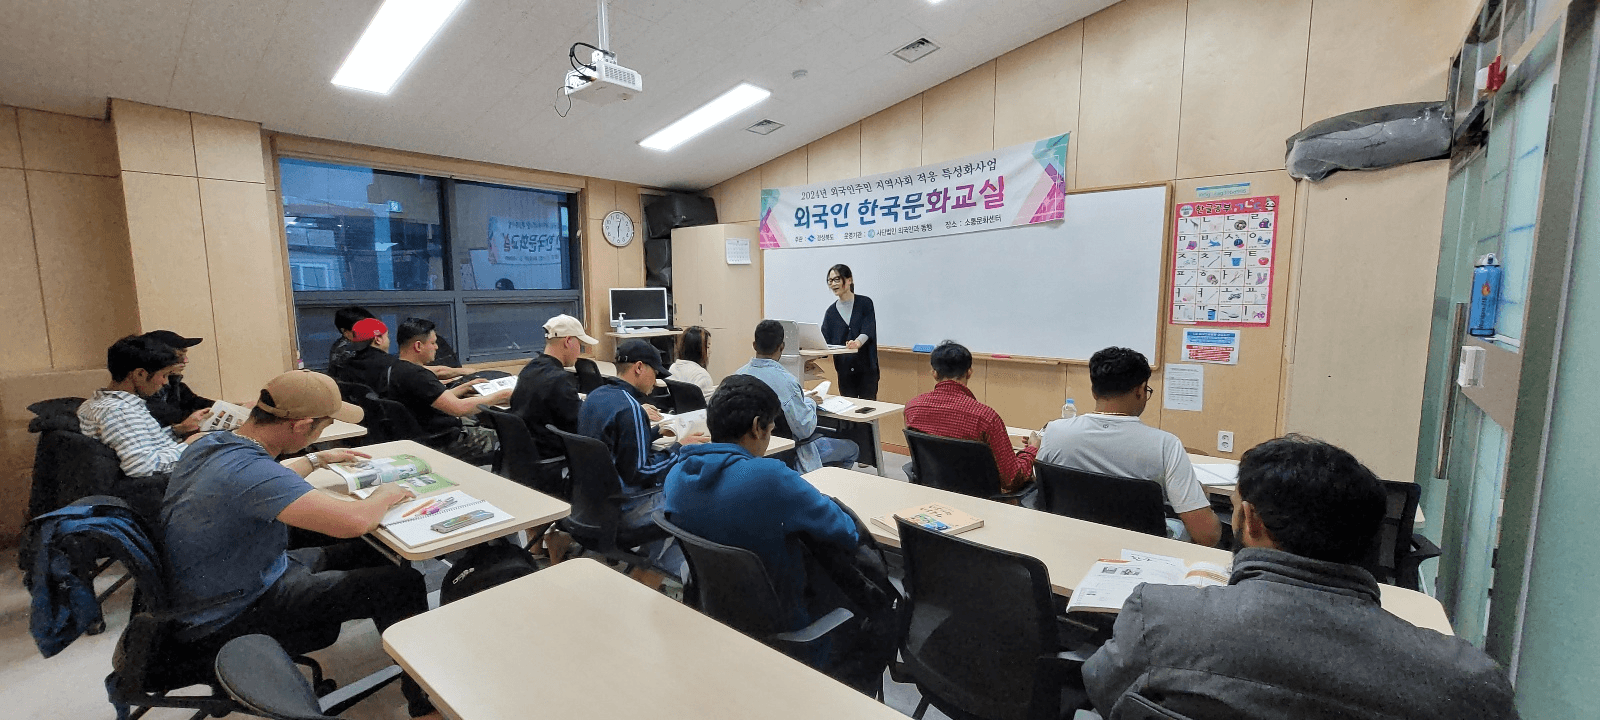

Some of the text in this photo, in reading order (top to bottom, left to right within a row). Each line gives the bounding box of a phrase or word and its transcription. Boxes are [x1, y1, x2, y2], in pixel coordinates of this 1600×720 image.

[801, 158, 997, 200] 2024년 외국인주민 지역사회 적응 특성화사업
[794, 175, 1005, 229] 외국인 한국문화교실
[1195, 202, 1232, 215] 한글공부
[945, 220, 958, 229] 장소
[964, 215, 1002, 226] 소통문화센터
[844, 231, 863, 240] 운영기관
[877, 227, 897, 237] 사단법인
[898, 225, 920, 235] 외국인과
[921, 223, 933, 232] 동행
